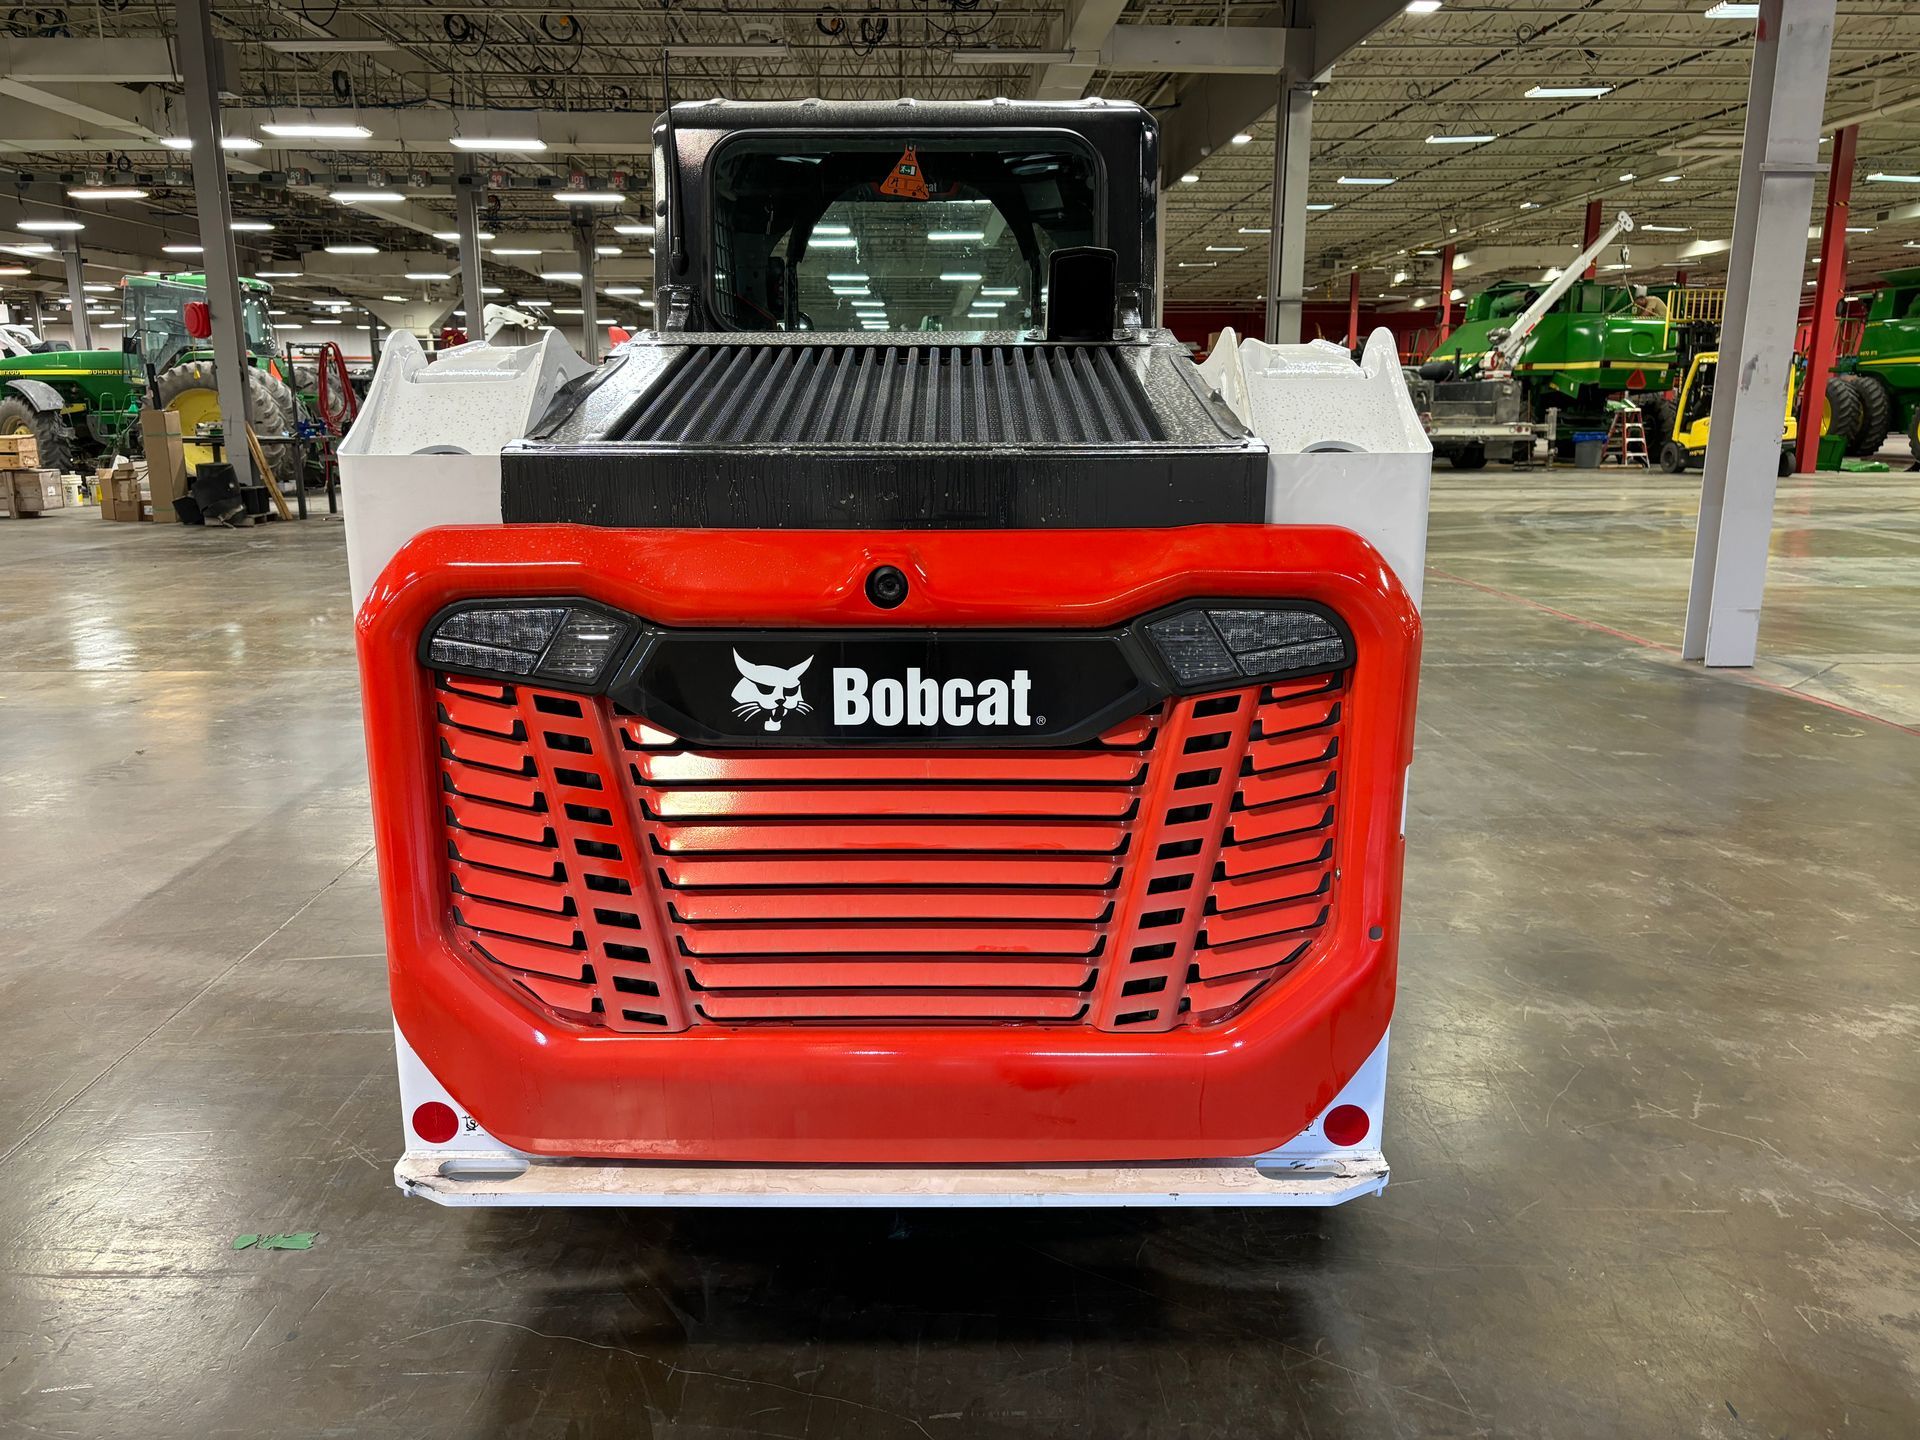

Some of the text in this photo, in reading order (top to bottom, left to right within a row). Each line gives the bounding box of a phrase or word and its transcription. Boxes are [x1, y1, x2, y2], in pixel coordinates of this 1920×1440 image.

[89, 171, 99, 180] 79
[371, 172, 381, 181] 93
[412, 174, 423, 183] 95
[491, 175, 502, 184] 99
[833, 667, 1032, 726] Bobcat
